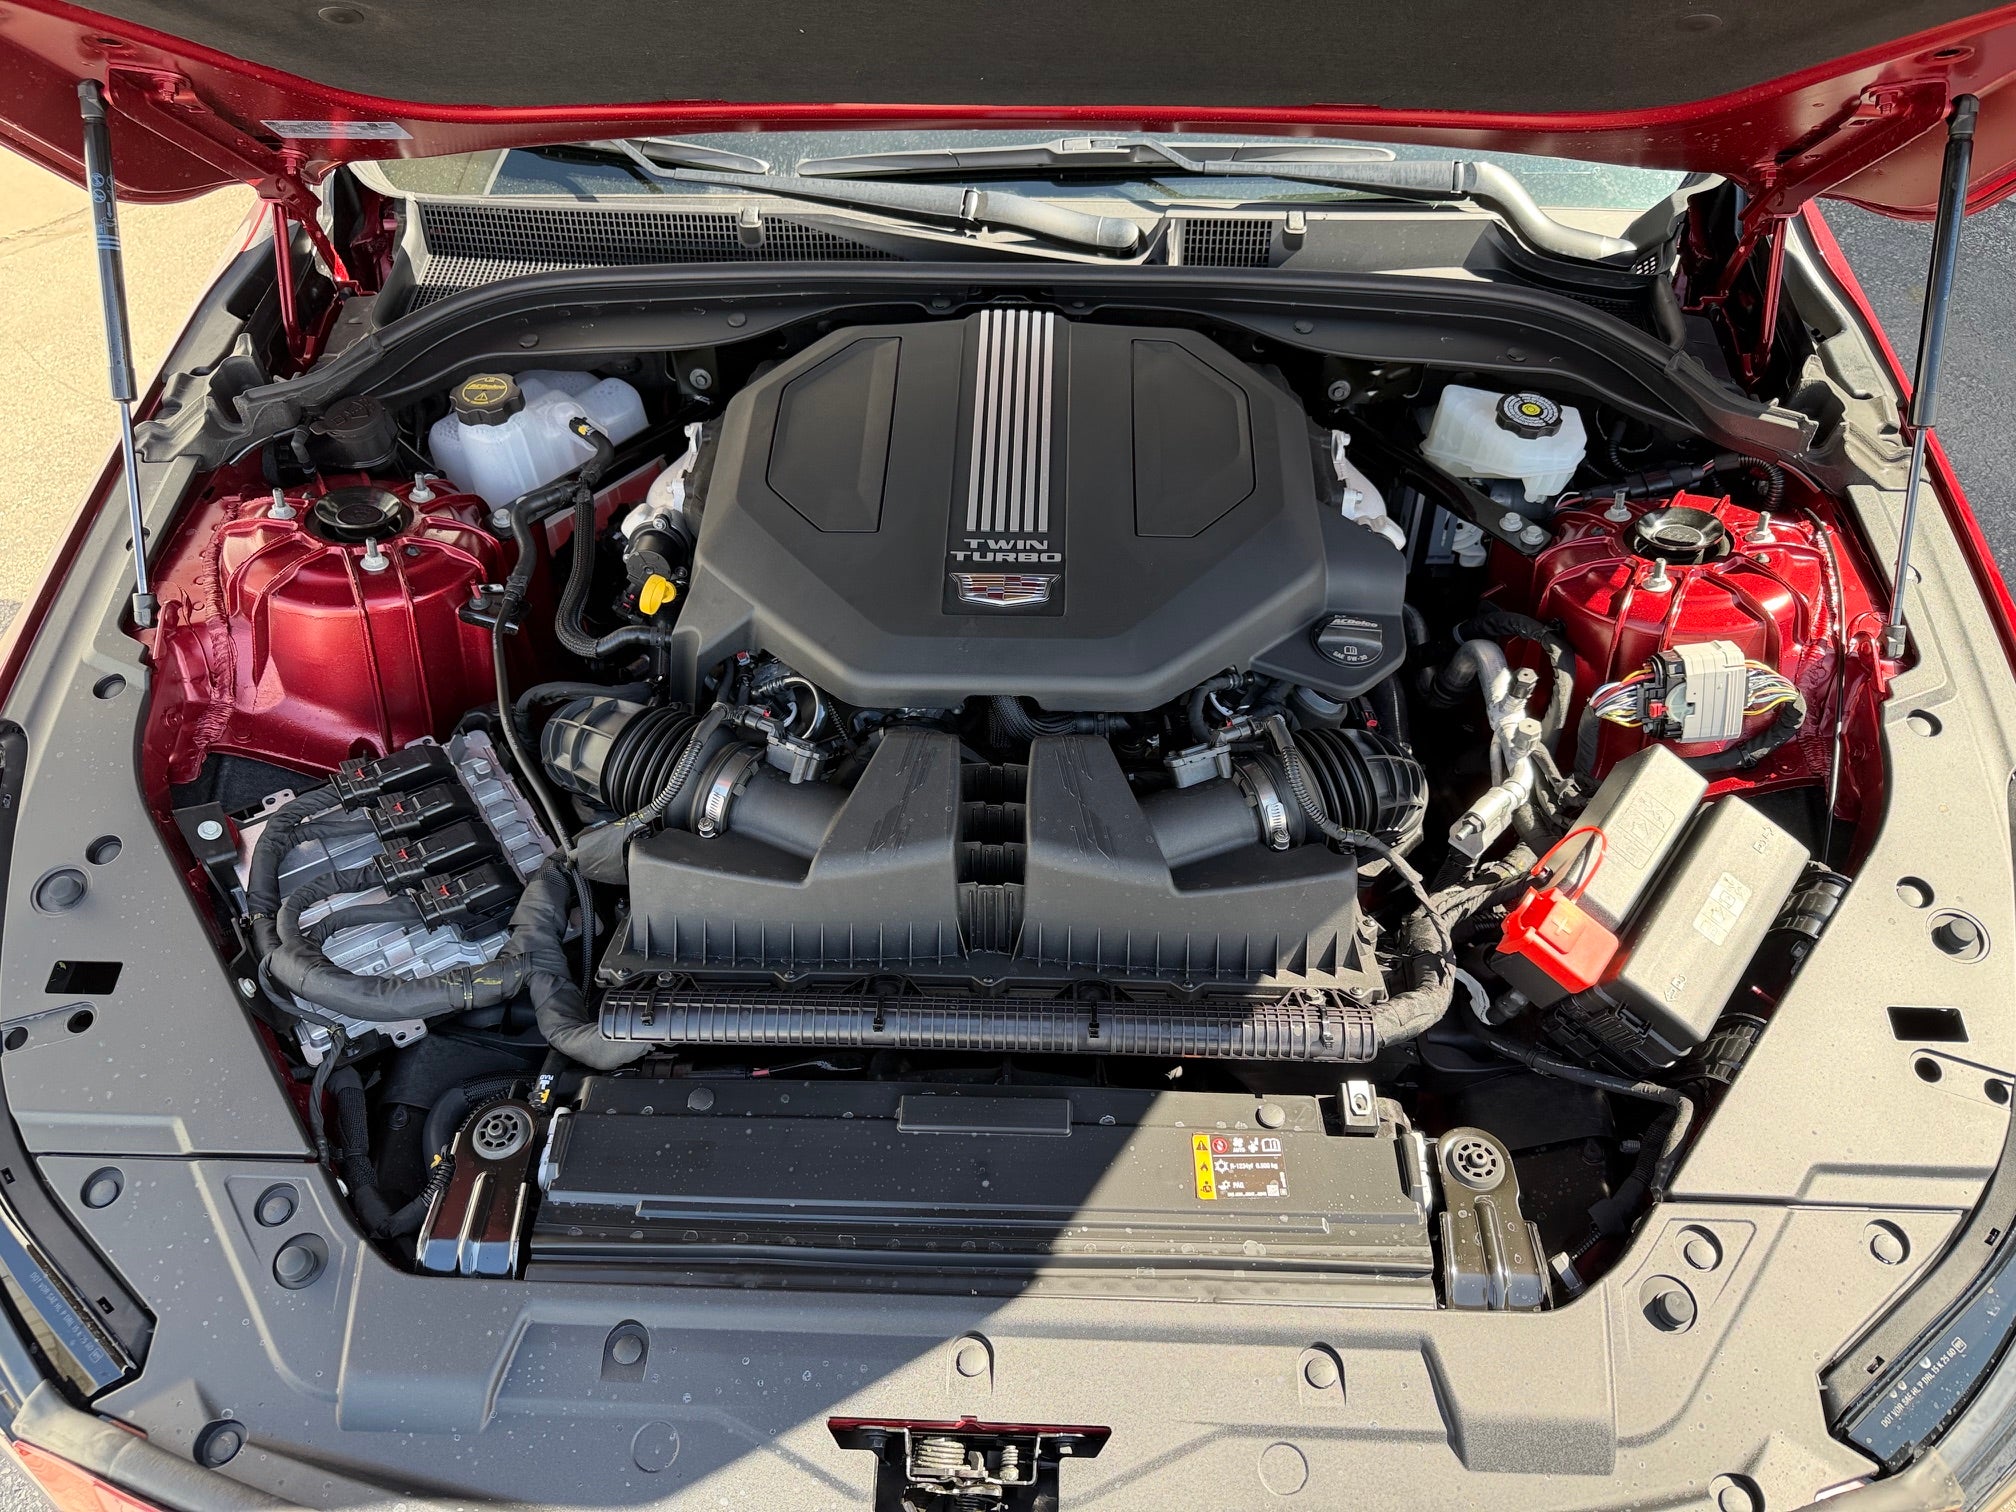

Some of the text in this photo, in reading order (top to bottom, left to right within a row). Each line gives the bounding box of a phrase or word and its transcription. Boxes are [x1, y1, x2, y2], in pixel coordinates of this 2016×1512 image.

[964, 539, 1048, 550] TWIN
[950, 551, 1062, 562] TURBO
[1330, 619, 1378, 627] ACDelco
[1332, 651, 1346, 660] SAE
[1881, 1414, 1894, 1428] DOT
[1901, 1392, 1914, 1406] SAE
[1911, 1386, 1921, 1396] HL
[1921, 1372, 1935, 1385] DRL
